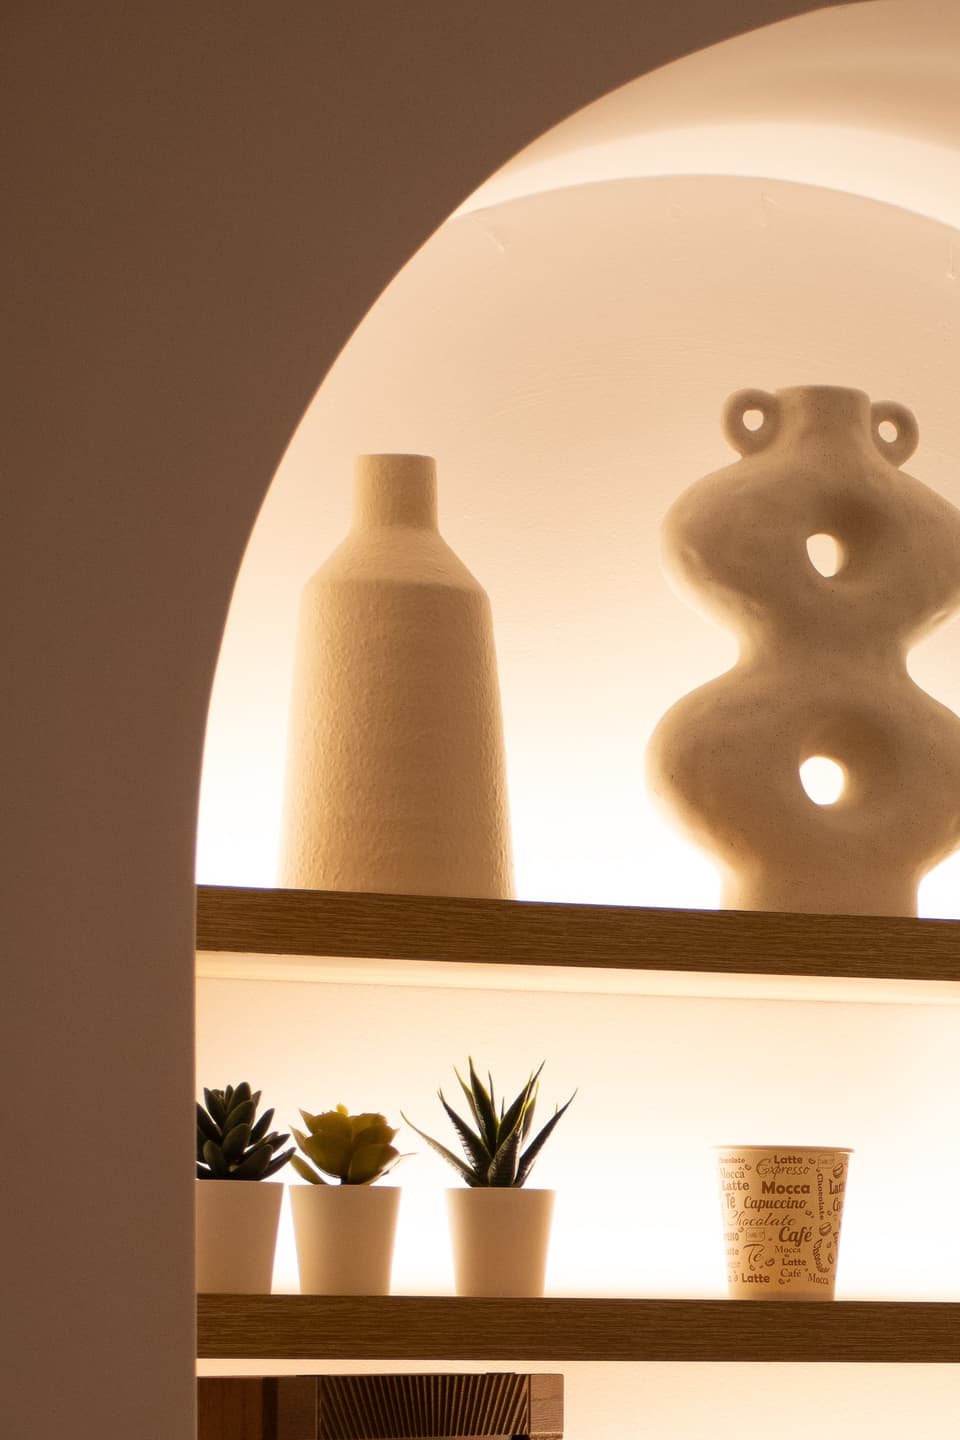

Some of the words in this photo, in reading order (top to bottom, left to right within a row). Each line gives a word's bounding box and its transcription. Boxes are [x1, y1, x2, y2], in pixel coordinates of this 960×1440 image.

[774, 1155, 803, 1164] Latte
[756, 1158, 810, 1179] Expresso
[761, 1181, 811, 1194] Mocca
[743, 1196, 807, 1212] Capuccino
[778, 1226, 813, 1247] Café
[782, 1257, 807, 1267] Latte
[741, 1273, 770, 1284] Latte
[780, 1267, 802, 1278] Café
